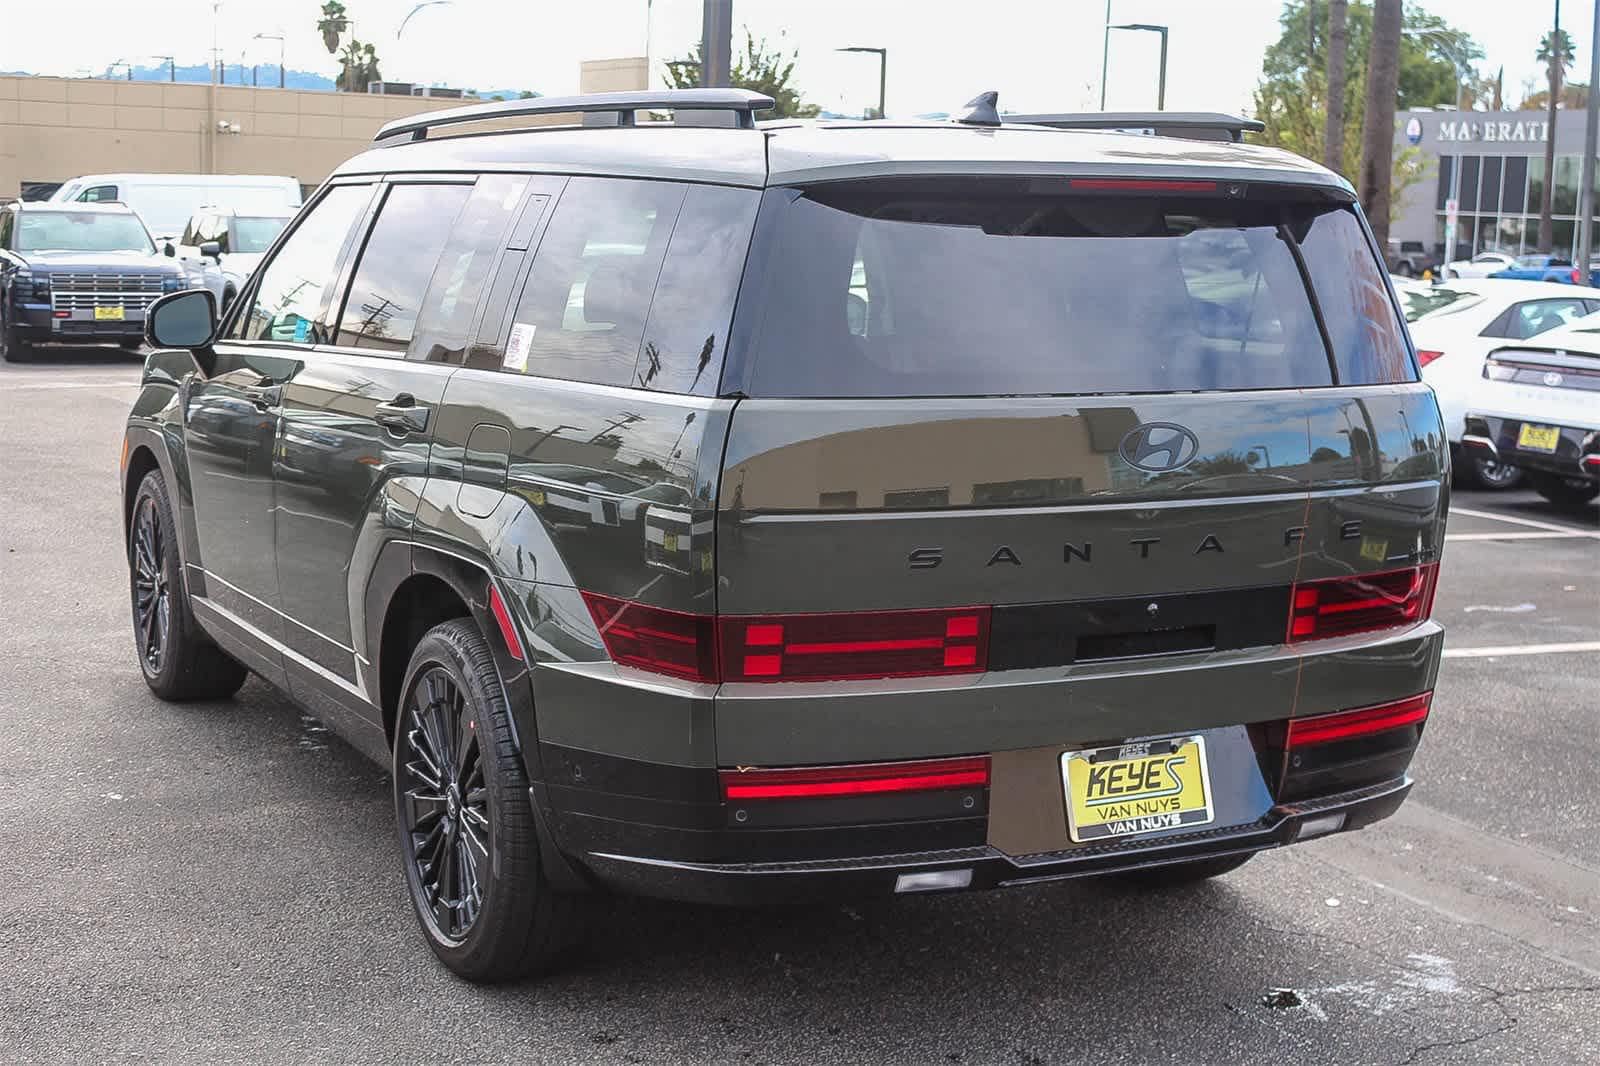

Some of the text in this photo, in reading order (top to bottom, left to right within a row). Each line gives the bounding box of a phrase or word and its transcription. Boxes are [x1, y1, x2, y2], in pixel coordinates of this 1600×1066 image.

[908, 520, 1362, 570] SANTA FE
[1118, 743, 1151, 756] KEYES
[1086, 755, 1186, 798] KEYES
[1097, 797, 1181, 820] VAN NUYS
[1106, 813, 1181, 835] VAN NUYS
